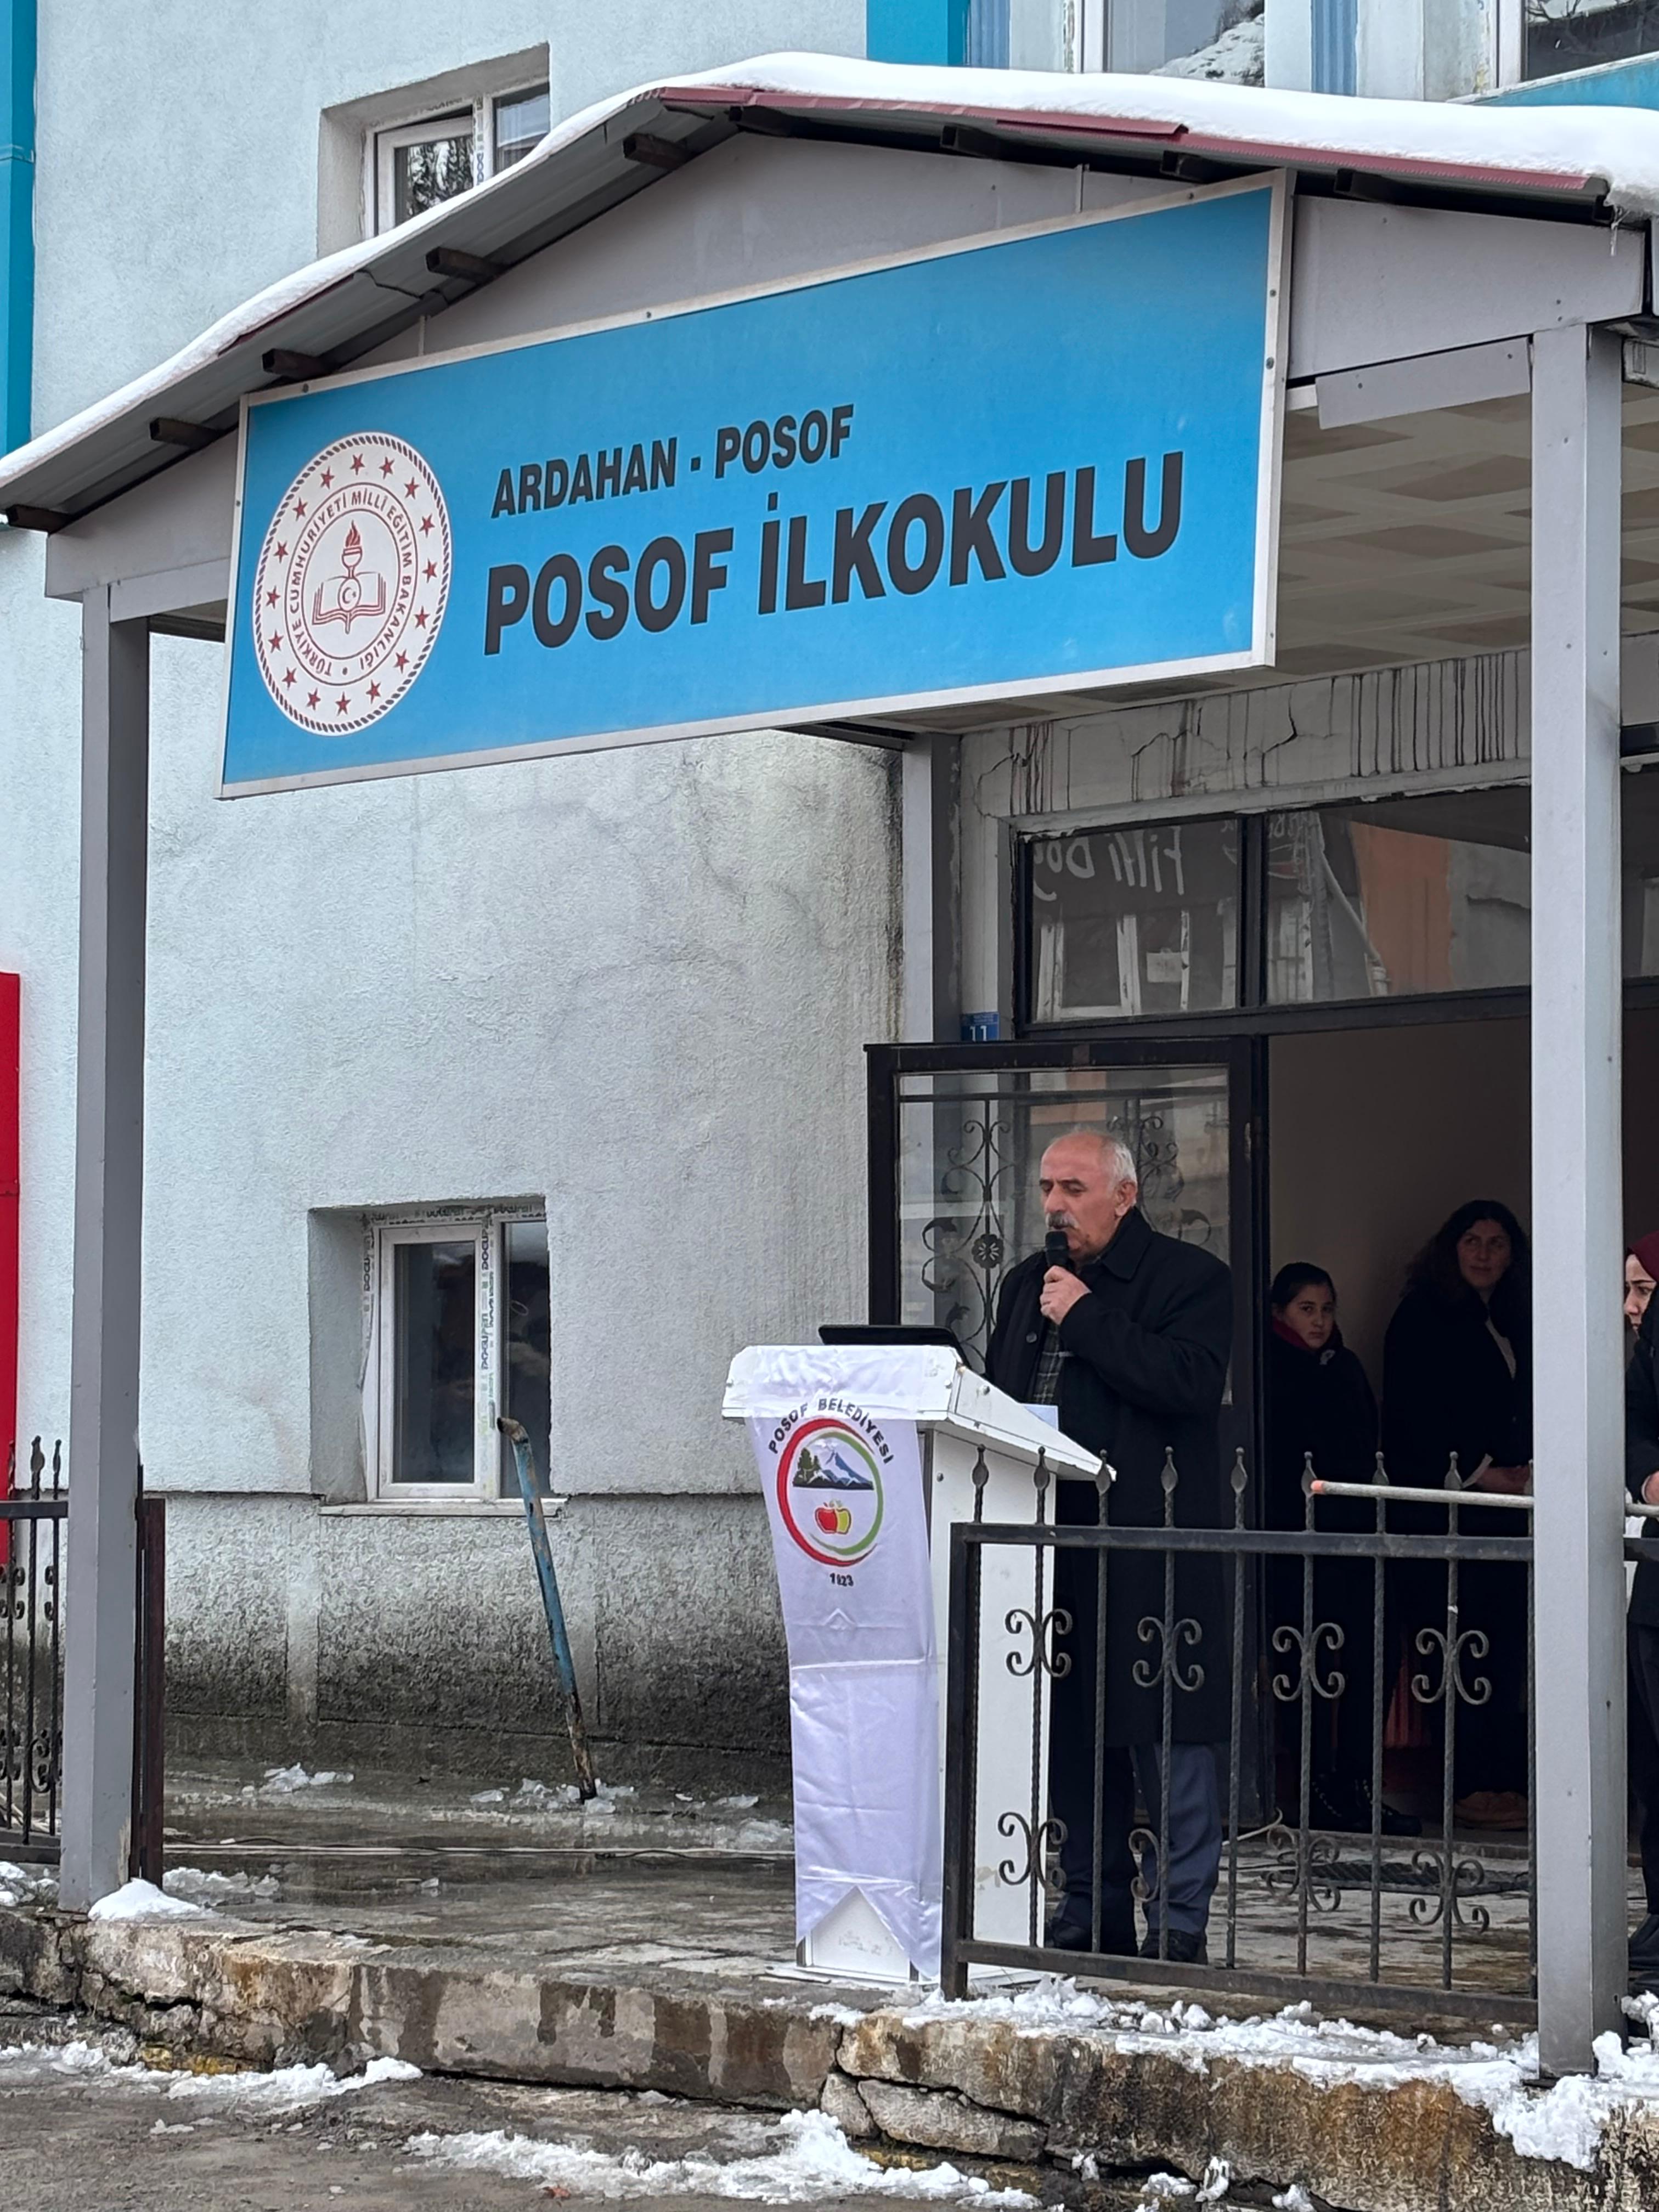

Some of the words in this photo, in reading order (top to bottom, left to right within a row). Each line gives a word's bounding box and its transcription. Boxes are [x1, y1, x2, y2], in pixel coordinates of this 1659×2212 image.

[491, 437, 678, 518] ARDAHAN
[715, 404, 854, 479] POSOF
[484, 527, 734, 656] POSOF
[758, 451, 1184, 615] İLKOKULU
[969, 1025, 987, 1042] 11
[768, 1402, 808, 1454] POSOF
